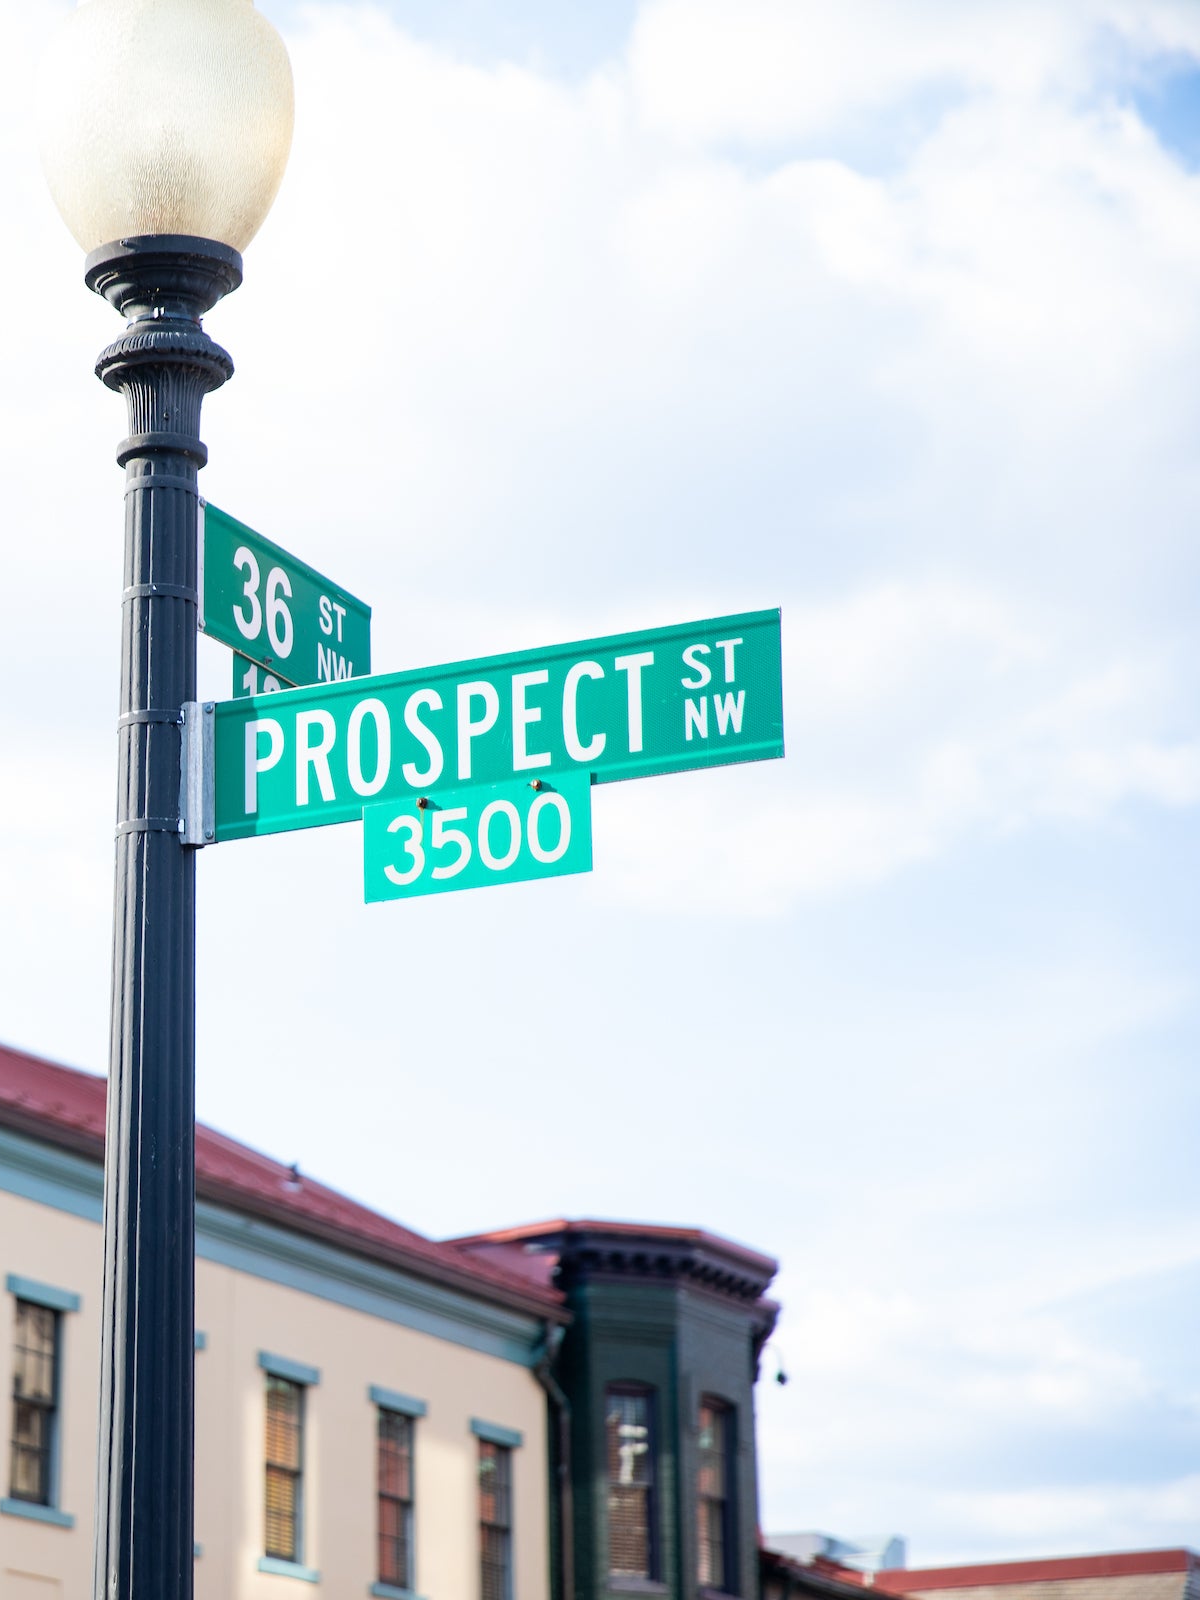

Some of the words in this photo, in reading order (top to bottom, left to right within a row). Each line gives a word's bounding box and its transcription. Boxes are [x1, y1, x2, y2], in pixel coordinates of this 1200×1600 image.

[233, 546, 294, 659] 36
[319, 595, 346, 642] ST
[318, 642, 353, 683] NW
[245, 652, 654, 813] PROSPECT
[681, 638, 743, 689] ST
[686, 691, 745, 740] NW
[385, 792, 571, 885] 3500
